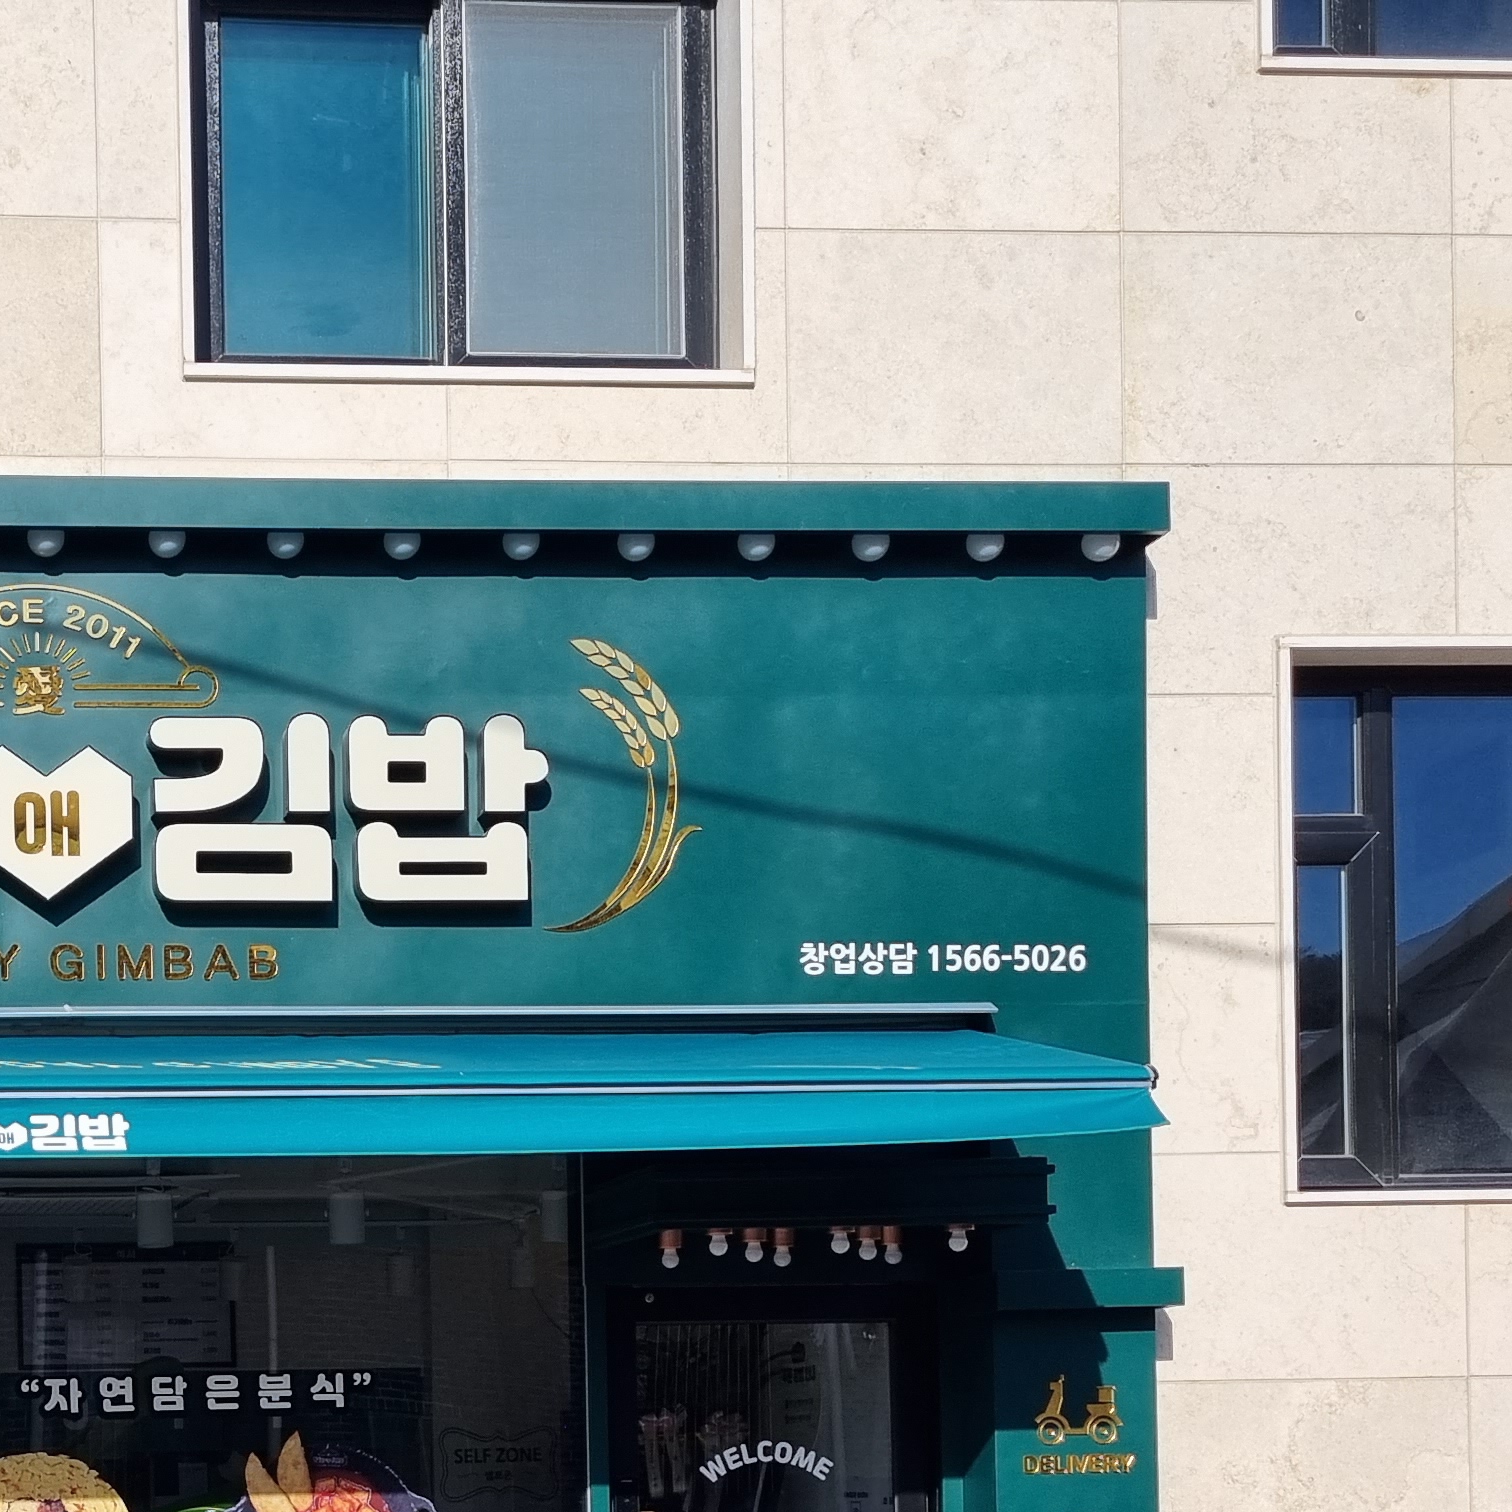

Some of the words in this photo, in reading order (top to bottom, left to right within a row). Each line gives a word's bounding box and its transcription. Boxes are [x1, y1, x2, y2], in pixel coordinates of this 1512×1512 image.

[62, 604, 141, 660] 2011
[49, 943, 281, 983] GIMBAB
[799, 942, 918, 975] 창업상담
[927, 944, 1087, 972] 1566-5026
[454, 1448, 491, 1464] SELF
[496, 1447, 543, 1463] ZONE
[699, 1440, 834, 1483] WELCOME
[1023, 1454, 1136, 1474] DELIVERY
